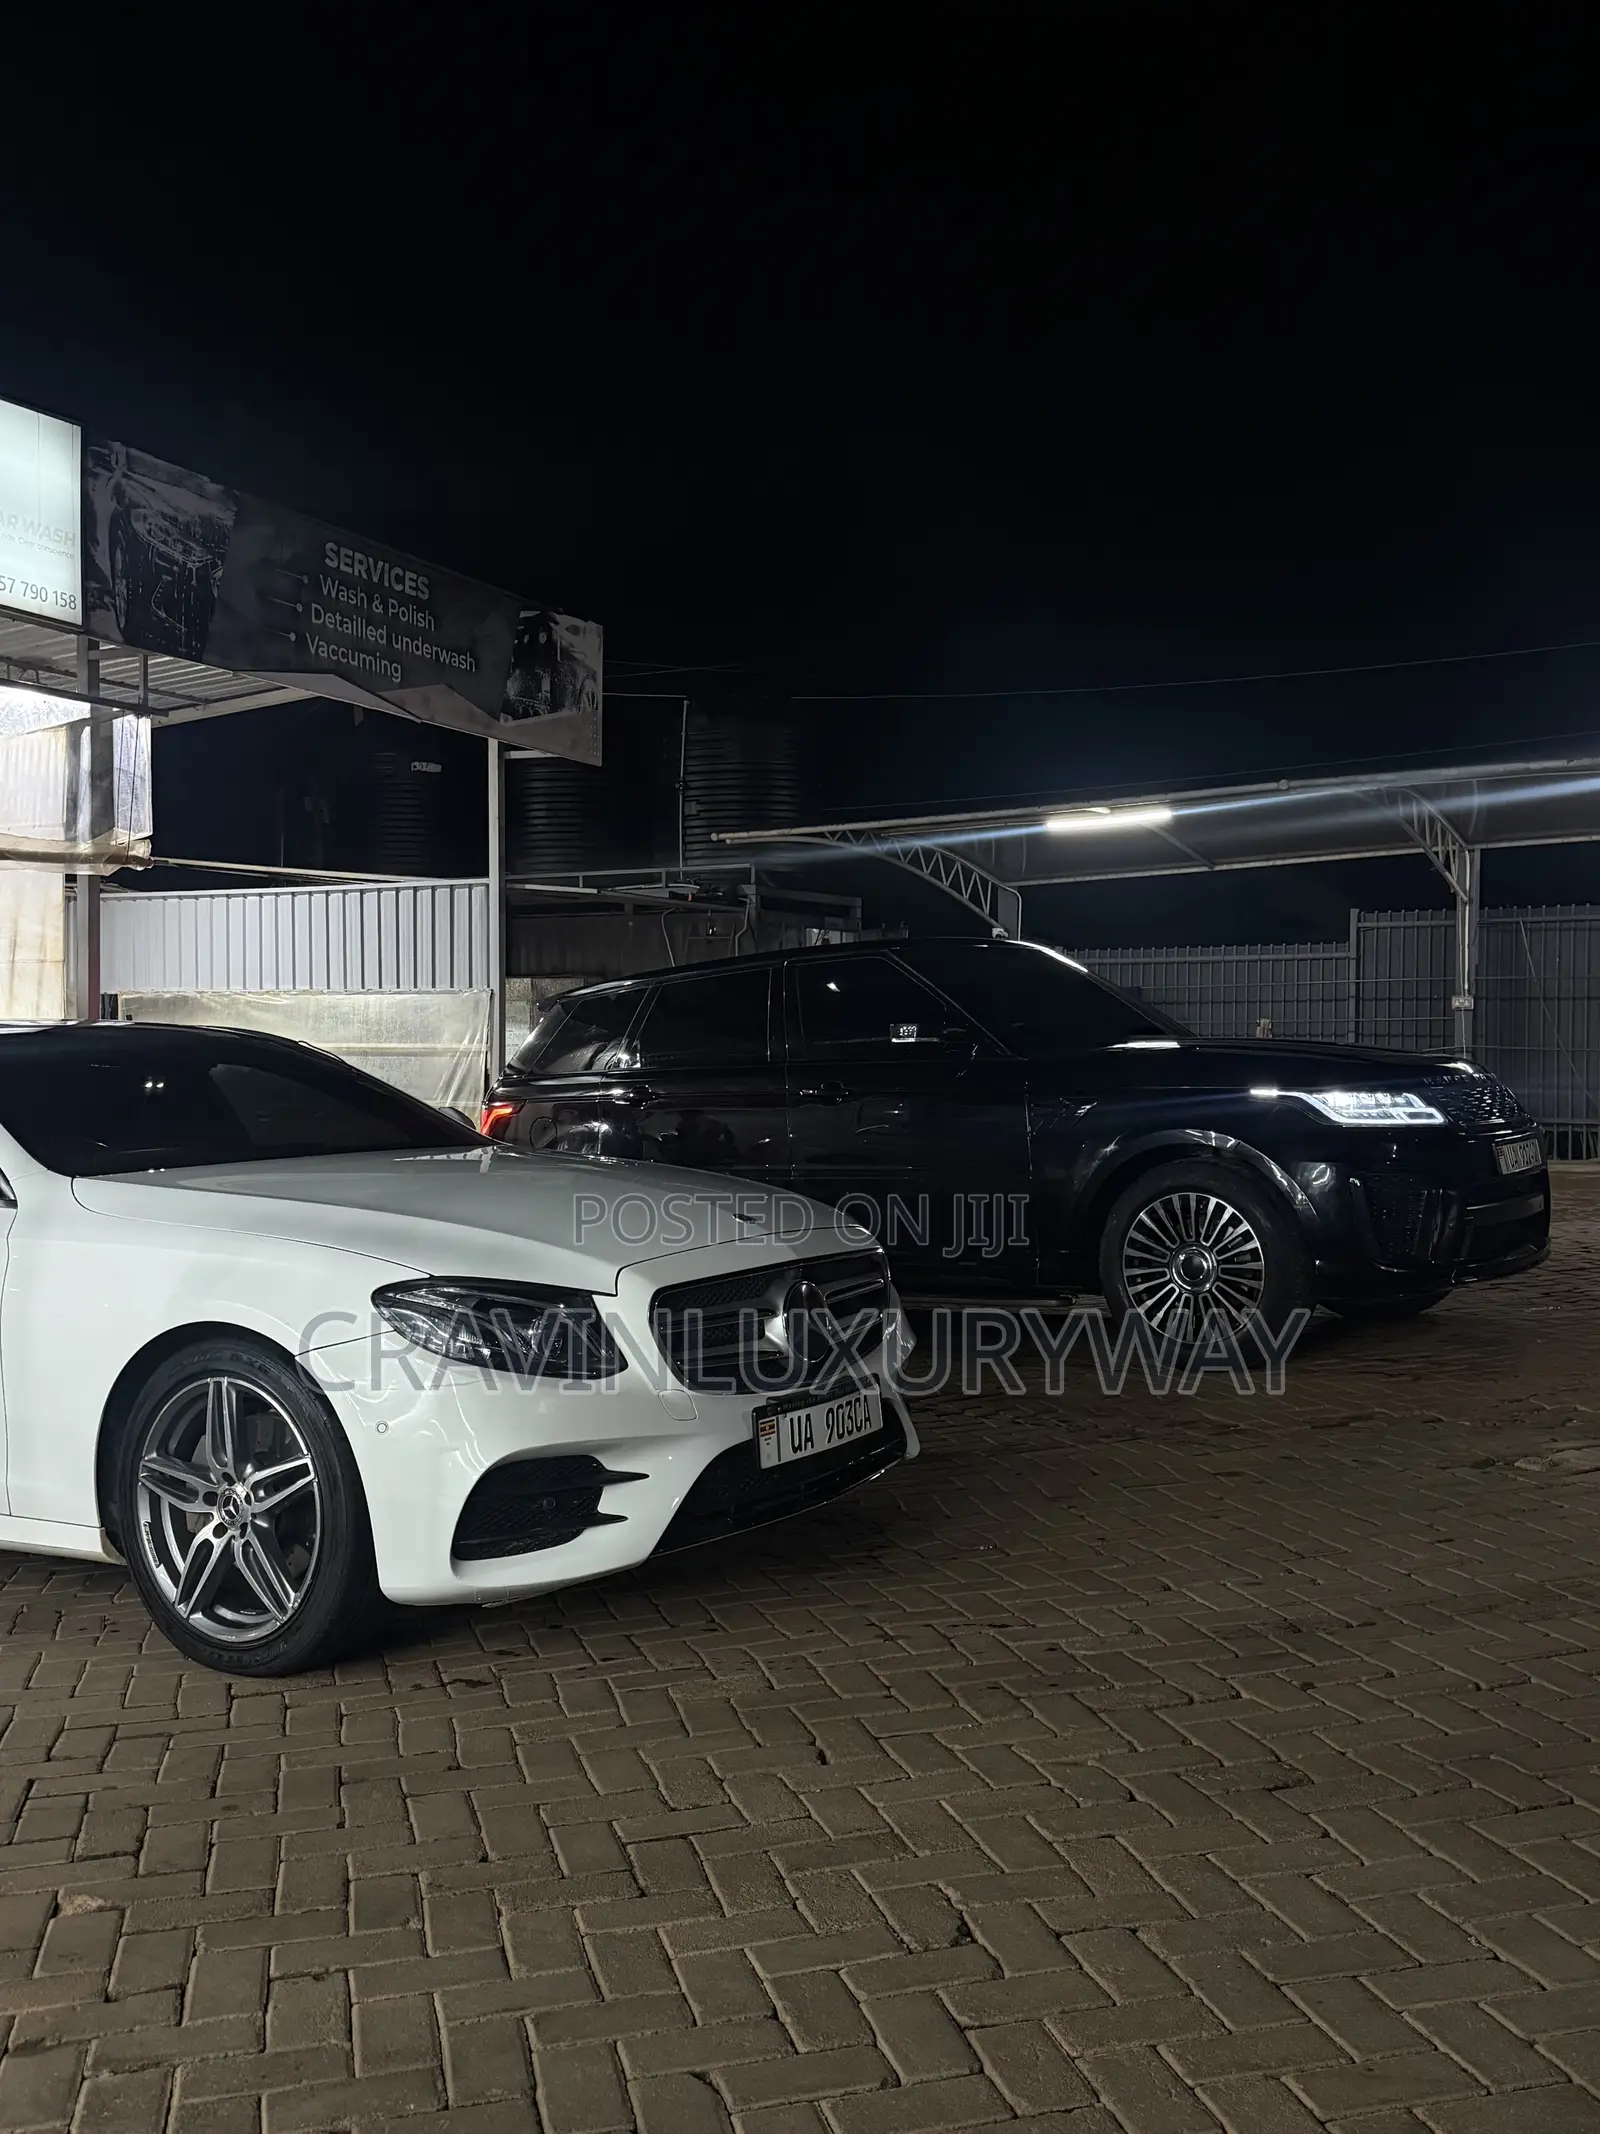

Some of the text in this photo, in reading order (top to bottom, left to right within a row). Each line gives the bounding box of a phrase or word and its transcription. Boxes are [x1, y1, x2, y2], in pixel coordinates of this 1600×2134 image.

[23, 517, 76, 547] WASH
[21, 580, 48, 603] 790
[53, 590, 77, 611] 158
[324, 542, 430, 600] SERVICES
[319, 574, 435, 632] Wash & Polish
[305, 632, 402, 683] Vaccuming
[311, 603, 476, 673] Detailled underwash
[790, 1413, 815, 1454] UA
[825, 1394, 872, 1445] 903CA
